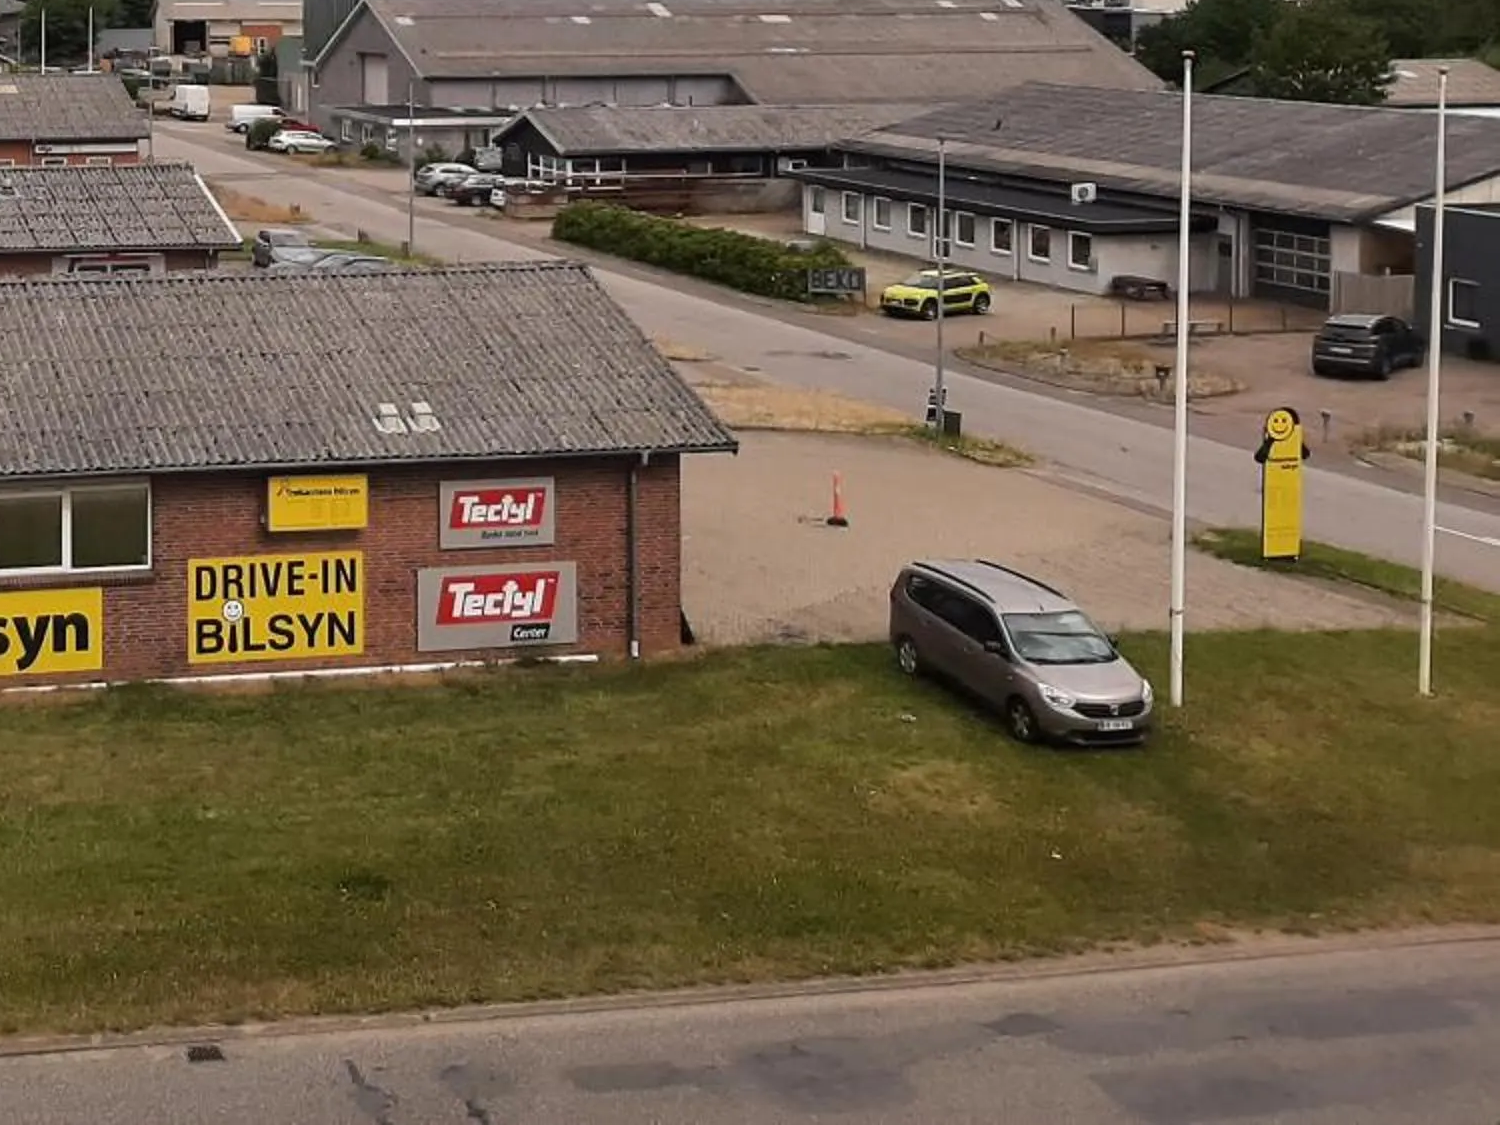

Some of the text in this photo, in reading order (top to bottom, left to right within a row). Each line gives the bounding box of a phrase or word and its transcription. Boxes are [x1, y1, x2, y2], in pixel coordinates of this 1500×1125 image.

[458, 493, 535, 524] Tectyl
[195, 558, 357, 601] DRIVE-IN
[448, 578, 545, 618] Tectyl
